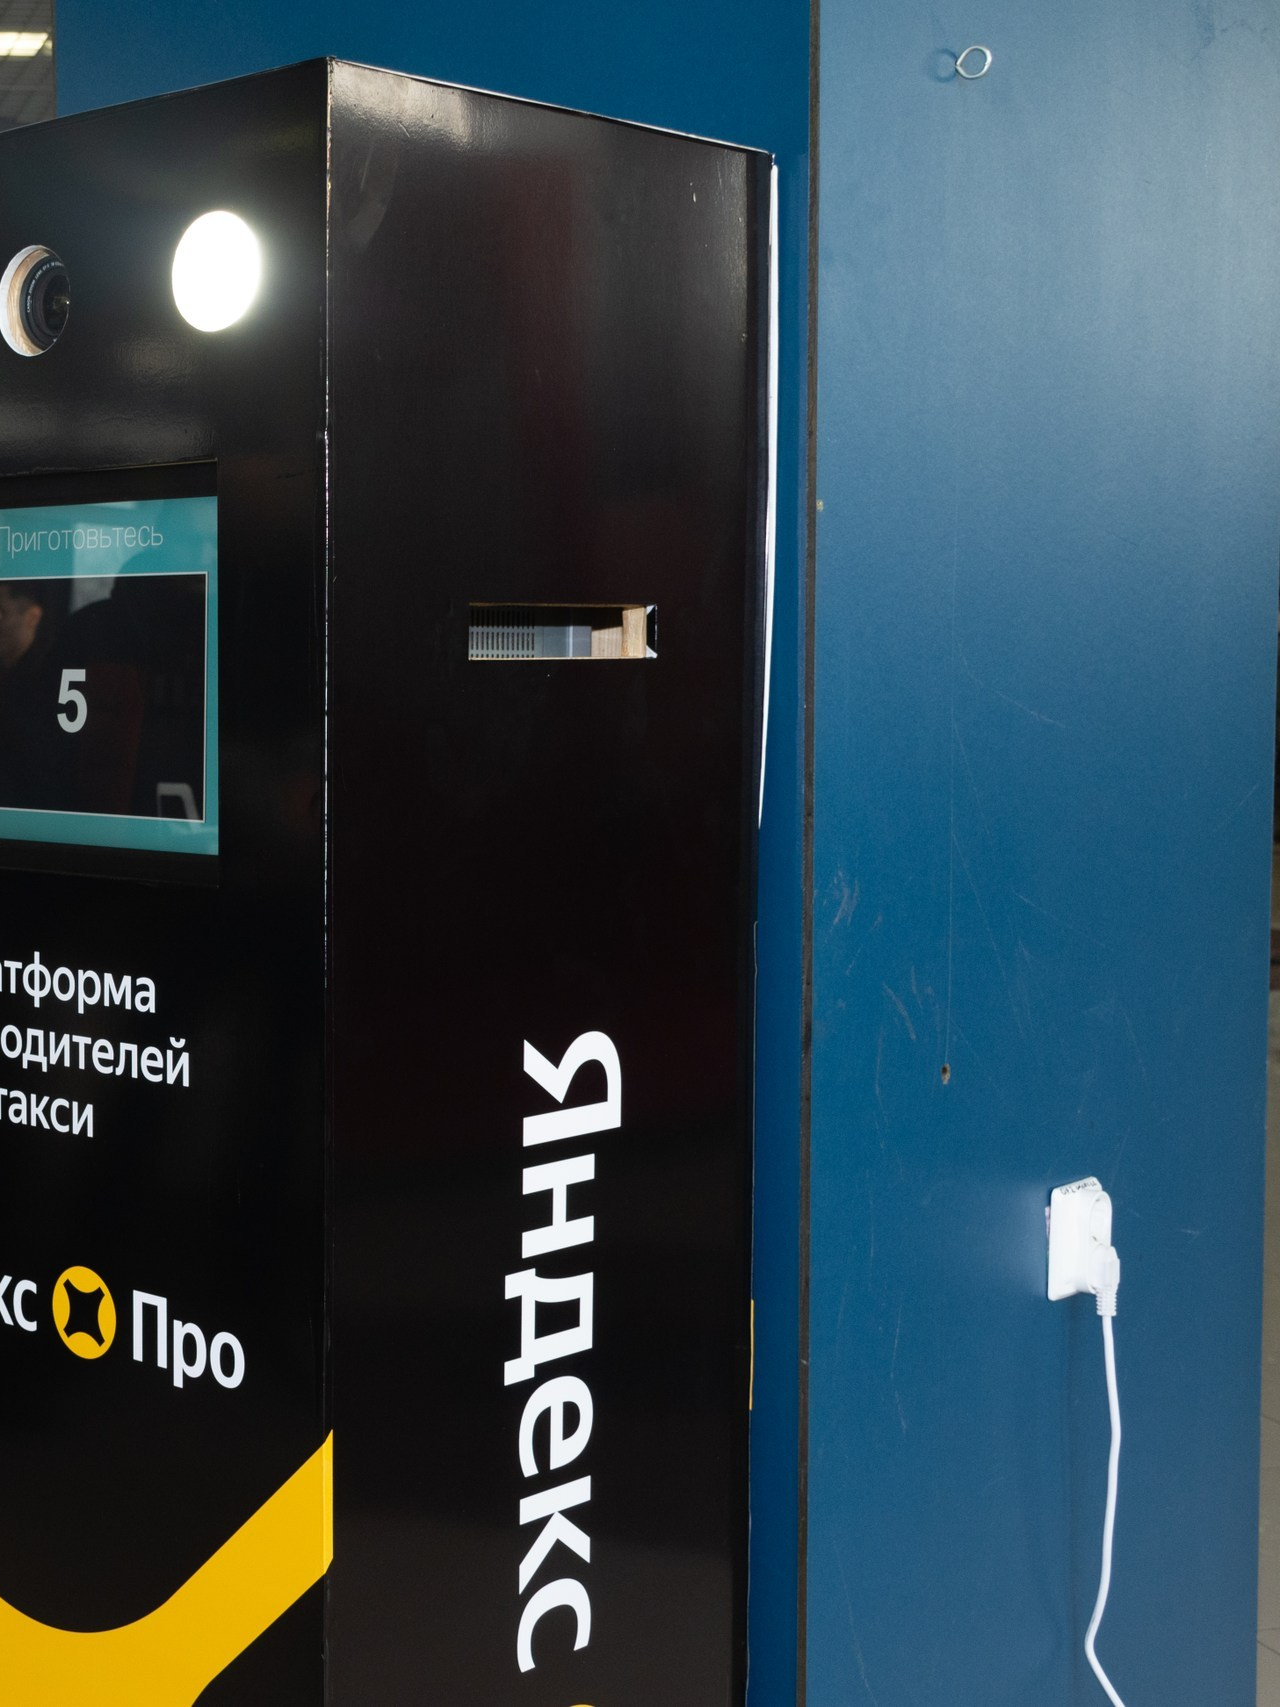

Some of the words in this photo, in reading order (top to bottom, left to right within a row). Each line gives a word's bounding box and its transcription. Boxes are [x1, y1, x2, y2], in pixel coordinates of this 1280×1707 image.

[57, 668, 88, 733] 5
[132, 1289, 246, 1389] Про
[503, 1030, 622, 1674] Яндекс
